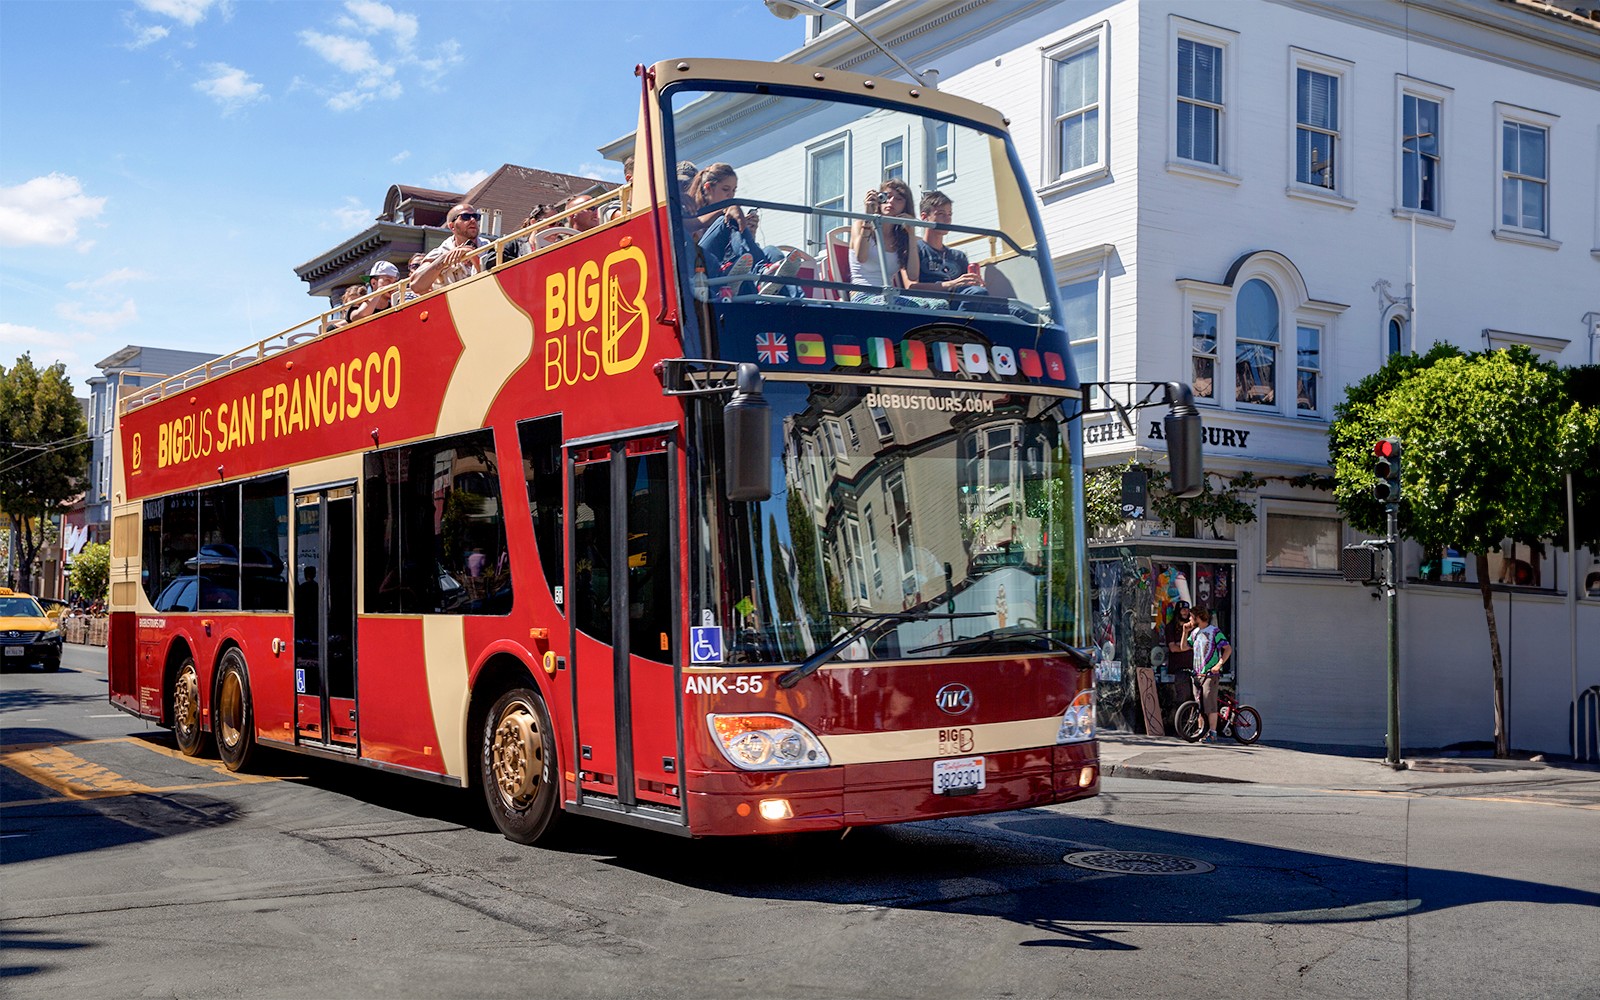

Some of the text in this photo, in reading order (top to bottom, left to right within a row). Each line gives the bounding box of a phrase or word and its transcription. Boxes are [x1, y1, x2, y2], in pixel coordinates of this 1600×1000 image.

[546, 260, 600, 333] BIG
[545, 326, 600, 391] BUS
[158, 345, 401, 468] BIGBUS SAN FRANCISCO
[866, 393, 994, 413] BIGBUSTOURS.COM
[1148, 421, 1250, 448] AURY
[704, 610, 712, 621] 2
[685, 675, 763, 695] ANK-55
[939, 729, 959, 742] BIG
[939, 742, 959, 755] BUS
[937, 769, 982, 789] 38293C1
